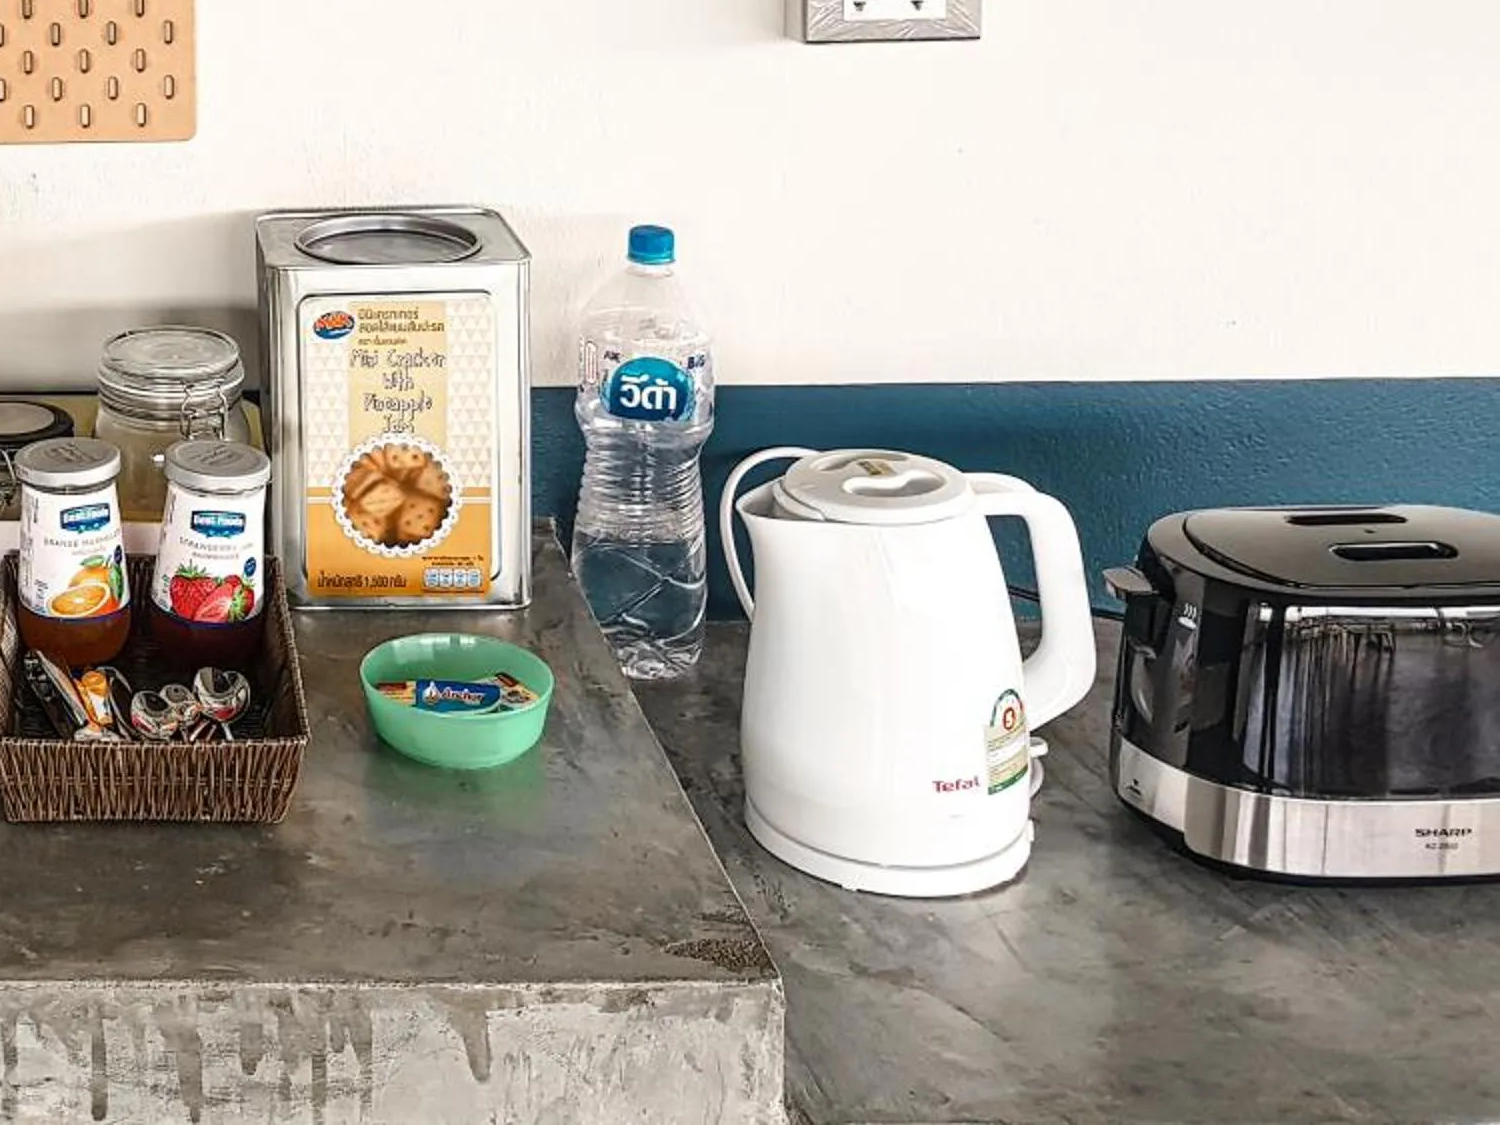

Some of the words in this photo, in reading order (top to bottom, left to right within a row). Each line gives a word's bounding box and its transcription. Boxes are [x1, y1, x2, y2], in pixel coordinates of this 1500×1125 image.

[351, 349, 378, 368] Mini
[932, 775, 981, 793] Tefal
[1415, 828, 1472, 838] SHARP
